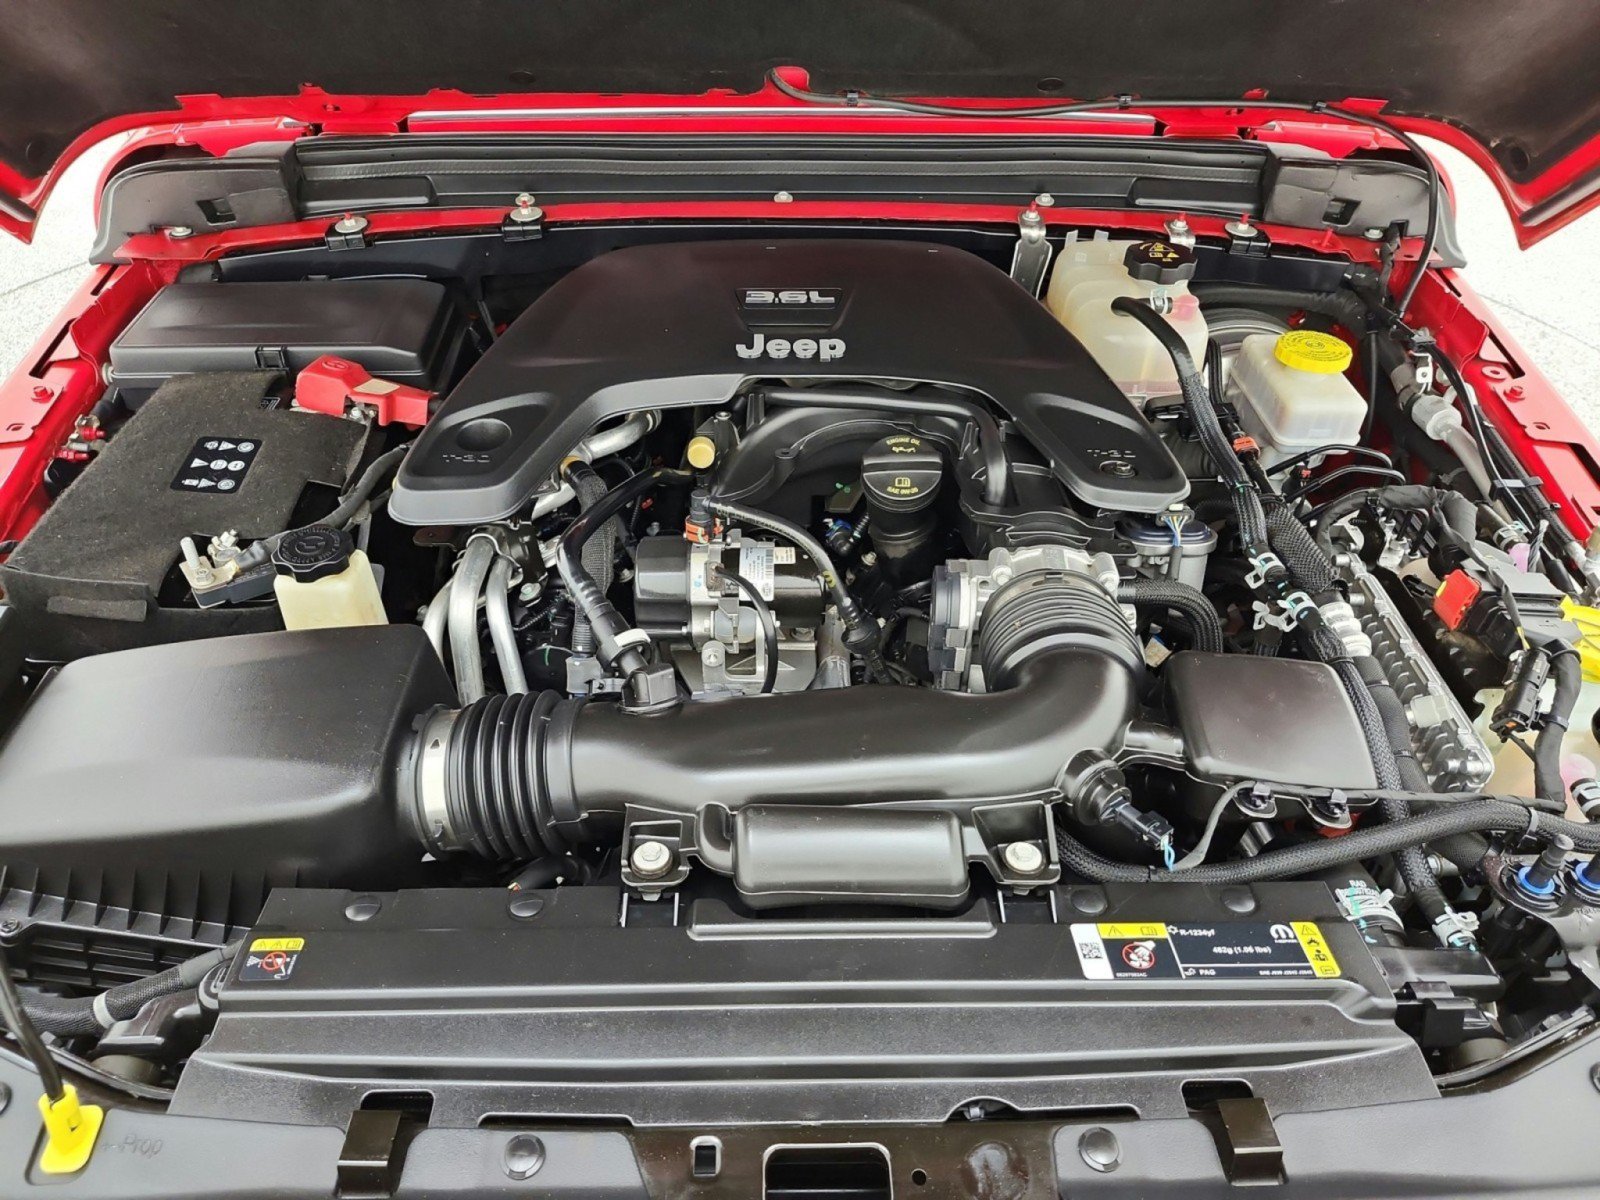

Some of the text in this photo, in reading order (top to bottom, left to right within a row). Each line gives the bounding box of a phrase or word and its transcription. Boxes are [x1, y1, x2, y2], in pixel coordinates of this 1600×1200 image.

[745, 291, 835, 304] 3.6L
[736, 333, 846, 362] Jeep
[886, 438, 920, 446] ENGINE OIL
[887, 486, 900, 494] SAE
[1179, 928, 1215, 937] R-1234yf
